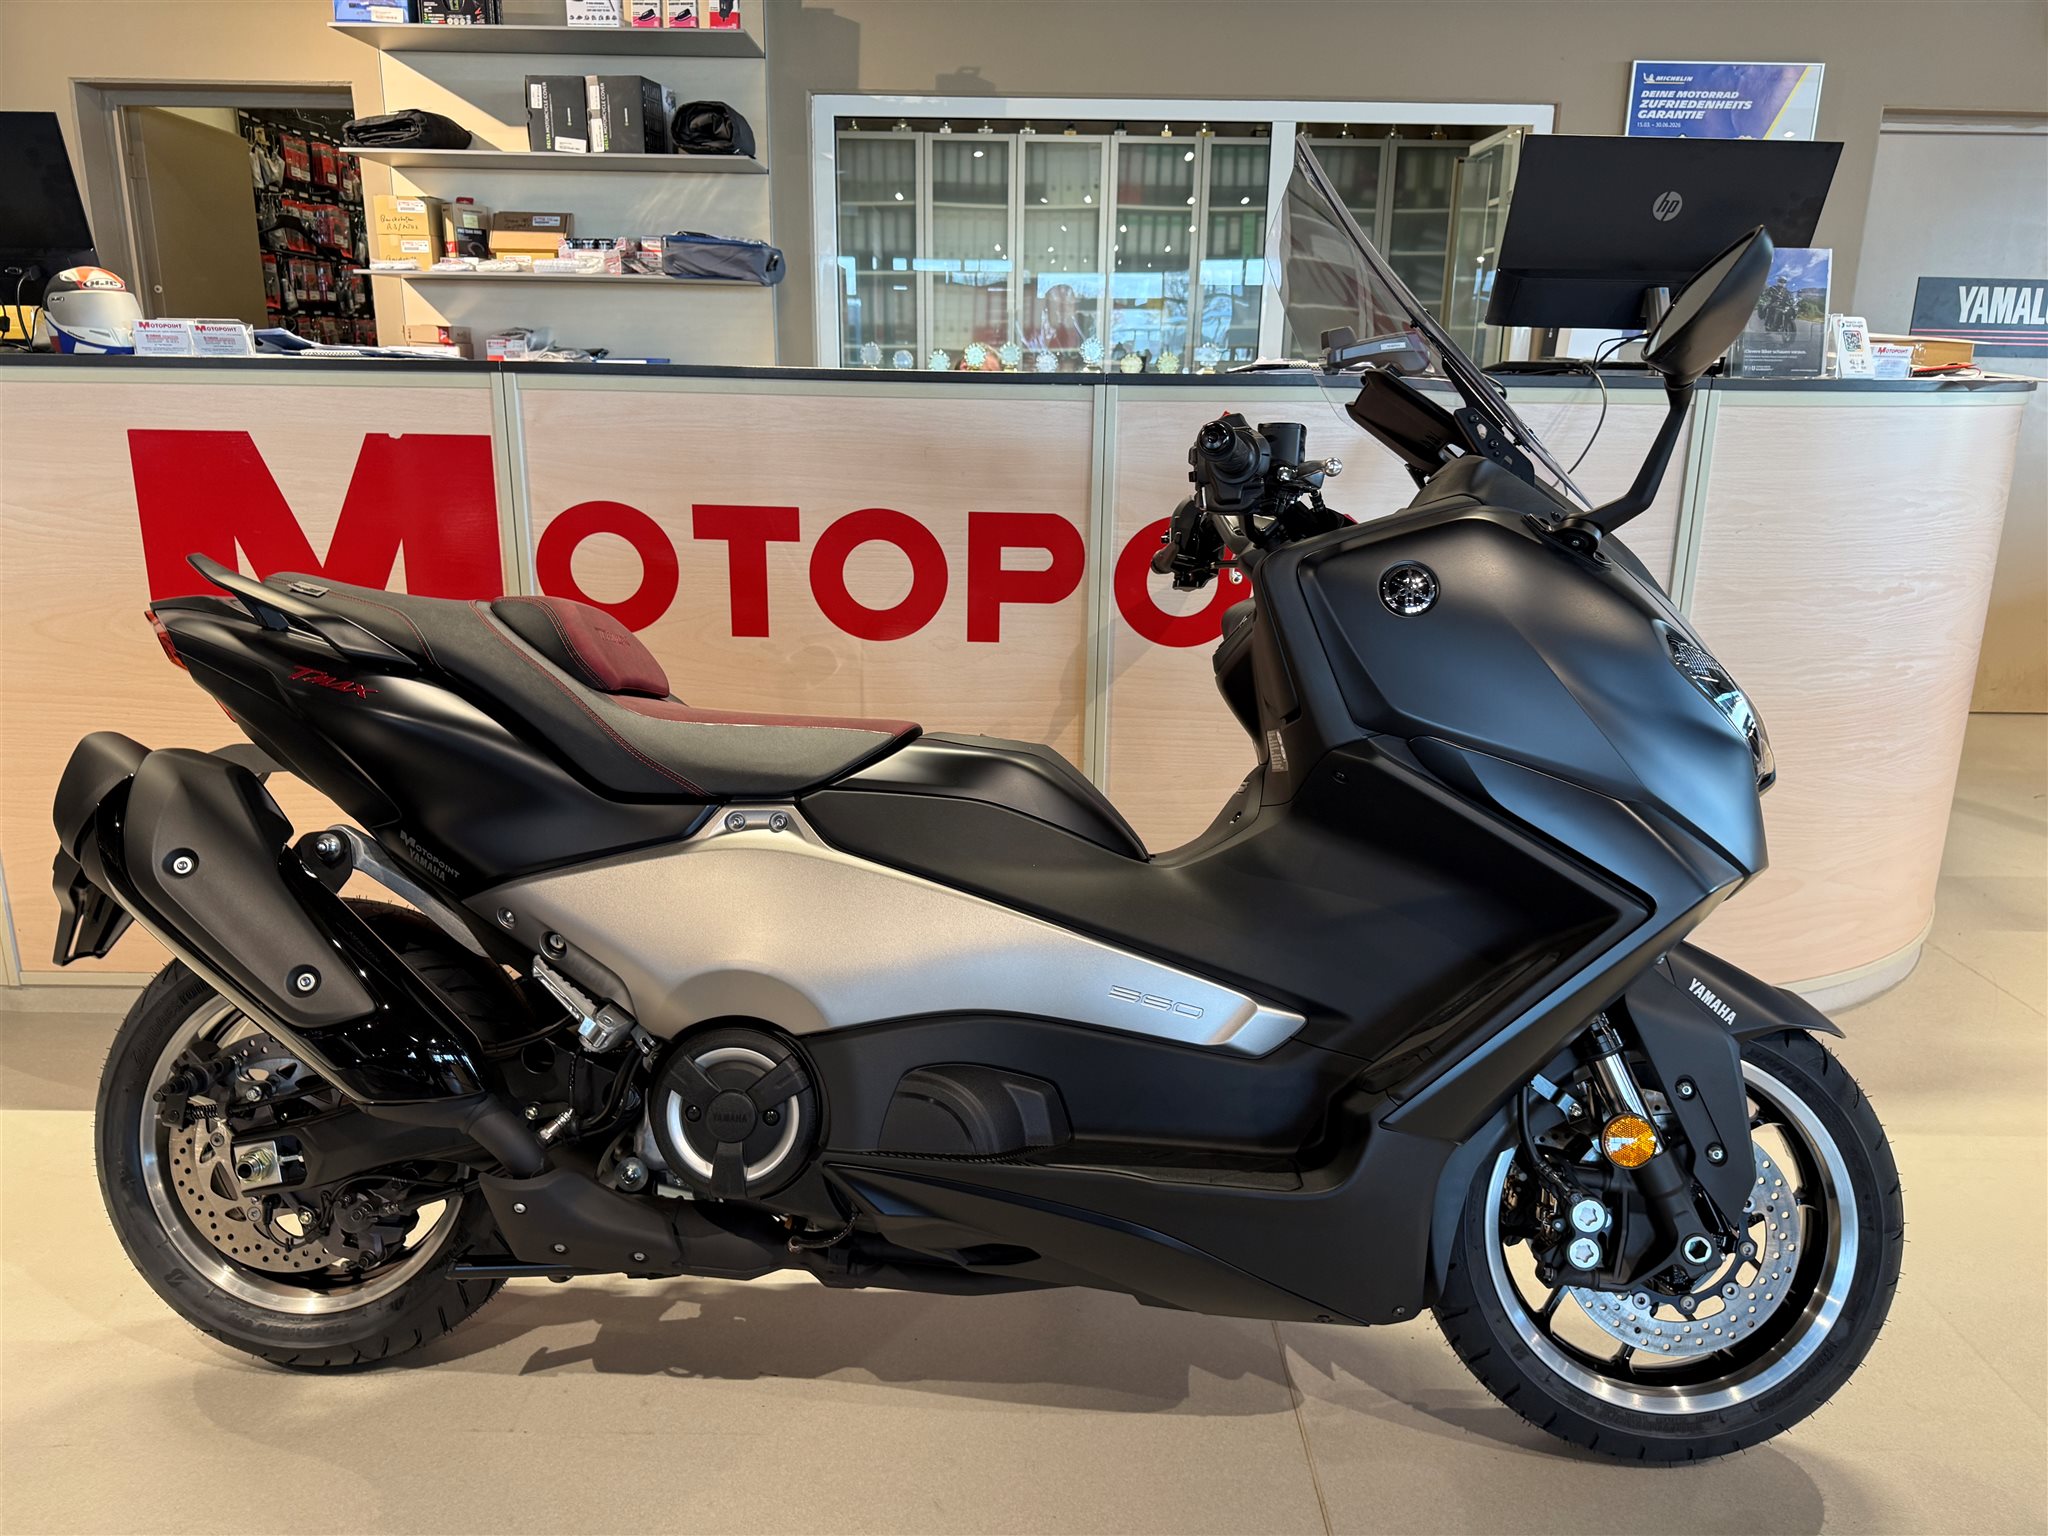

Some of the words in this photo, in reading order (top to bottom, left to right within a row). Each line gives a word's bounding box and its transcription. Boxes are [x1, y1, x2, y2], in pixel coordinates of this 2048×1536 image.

[1639, 100, 1753, 110] ZUFRIEDENHEITS
[1641, 90, 1676, 98] DEINE
[1676, 91, 1739, 99] MOTORRAD
[543, 100, 551, 133] MOTORCYCLE
[600, 100, 608, 133] MOTORCYCLE
[1637, 110, 1706, 119] GARANTIE
[1655, 191, 1681, 221] hp
[1958, 286, 2048, 325] YAMAL
[138, 321, 182, 330] MOTOPOINT
[194, 325, 237, 333] MOTOPOINT
[400, 830, 460, 879] MOTOPOINT
[409, 849, 446, 881] YAMAHA
[1108, 984, 1205, 1020] 560
[1688, 977, 1737, 1026] YAMAHA
